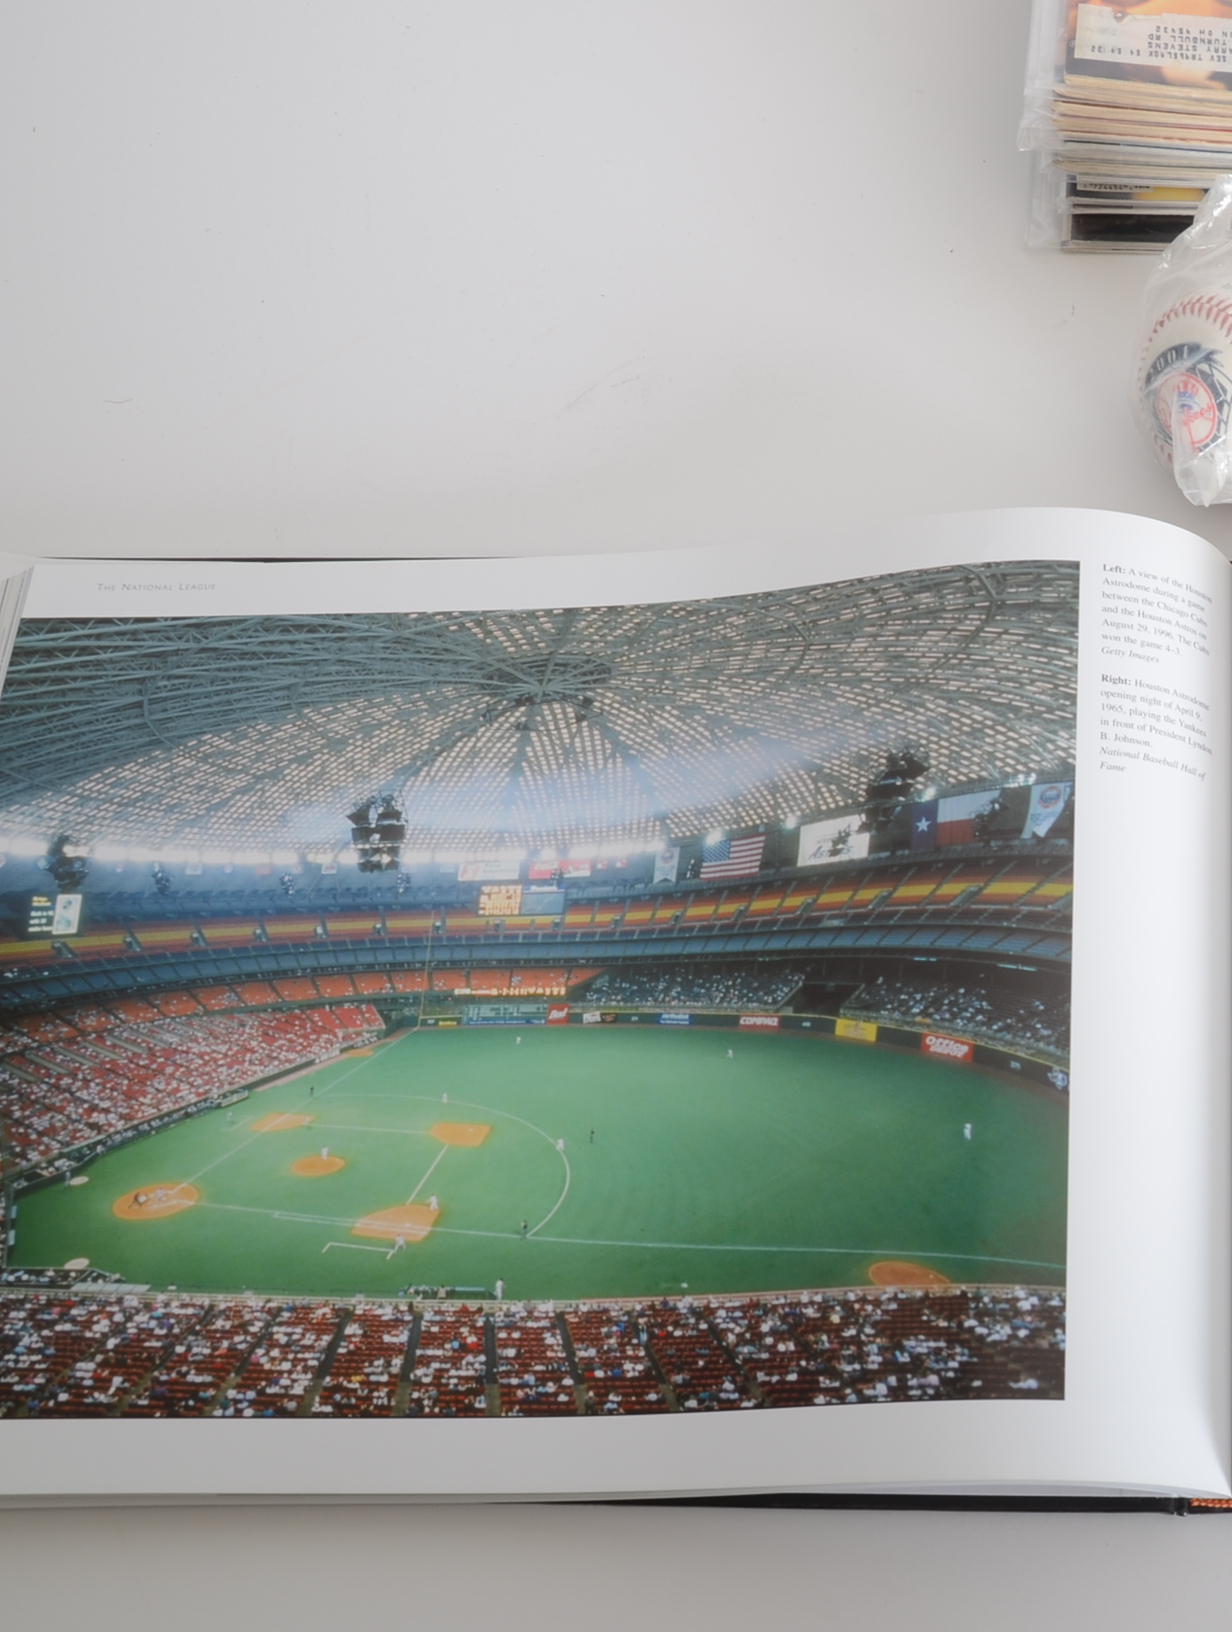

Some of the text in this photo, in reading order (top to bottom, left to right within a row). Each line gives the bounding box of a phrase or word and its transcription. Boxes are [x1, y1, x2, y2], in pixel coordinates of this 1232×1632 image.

[1148, 33, 1161, 41] RD
[1169, 35, 1227, 46] TURNBULL
[1199, 28, 1213, 37] OH
[1147, 41, 1198, 52] STEVENS
[1103, 563, 1125, 575] Left:
[1128, 568, 1136, 576] A
[1139, 571, 1158, 581] view
[1161, 576, 1170, 584] of
[1171, 579, 1184, 589] the
[121, 583, 174, 592] NATIONAL
[178, 583, 216, 591] LEAGUE
[1102, 578, 1151, 593] Astrodome
[1152, 587, 1179, 602] during
[1187, 600, 1206, 613] game
[1102, 591, 1208, 627] between the Chicago Cubs
[1101, 606, 1208, 641] and the Houston Astros on
[1101, 634, 1121, 642] won
[1123, 636, 1137, 645] the
[1140, 641, 1163, 651] game
[1102, 618, 1134, 630] August
[1177, 634, 1192, 646] The
[1193, 641, 1210, 656] Cubs
[1101, 646, 1160, 663] Getty Images
[1101, 674, 1131, 686] Right:
[1134, 679, 1170, 695] Houston
[1100, 690, 1137, 703] opening
[1139, 695, 1162, 707] night
[1163, 701, 1173, 709] of
[1174, 704, 1194, 717] April
[1129, 707, 1162, 723] playing
[1163, 714, 1176, 725] the
[1178, 718, 1207, 738] Yankees
[1100, 717, 1213, 756] in front of President Lyndon
[1100, 732, 1153, 748] B. Johnson.
[1100, 746, 1207, 781] National Baseball Hall of
[1100, 761, 1126, 773] Fame
